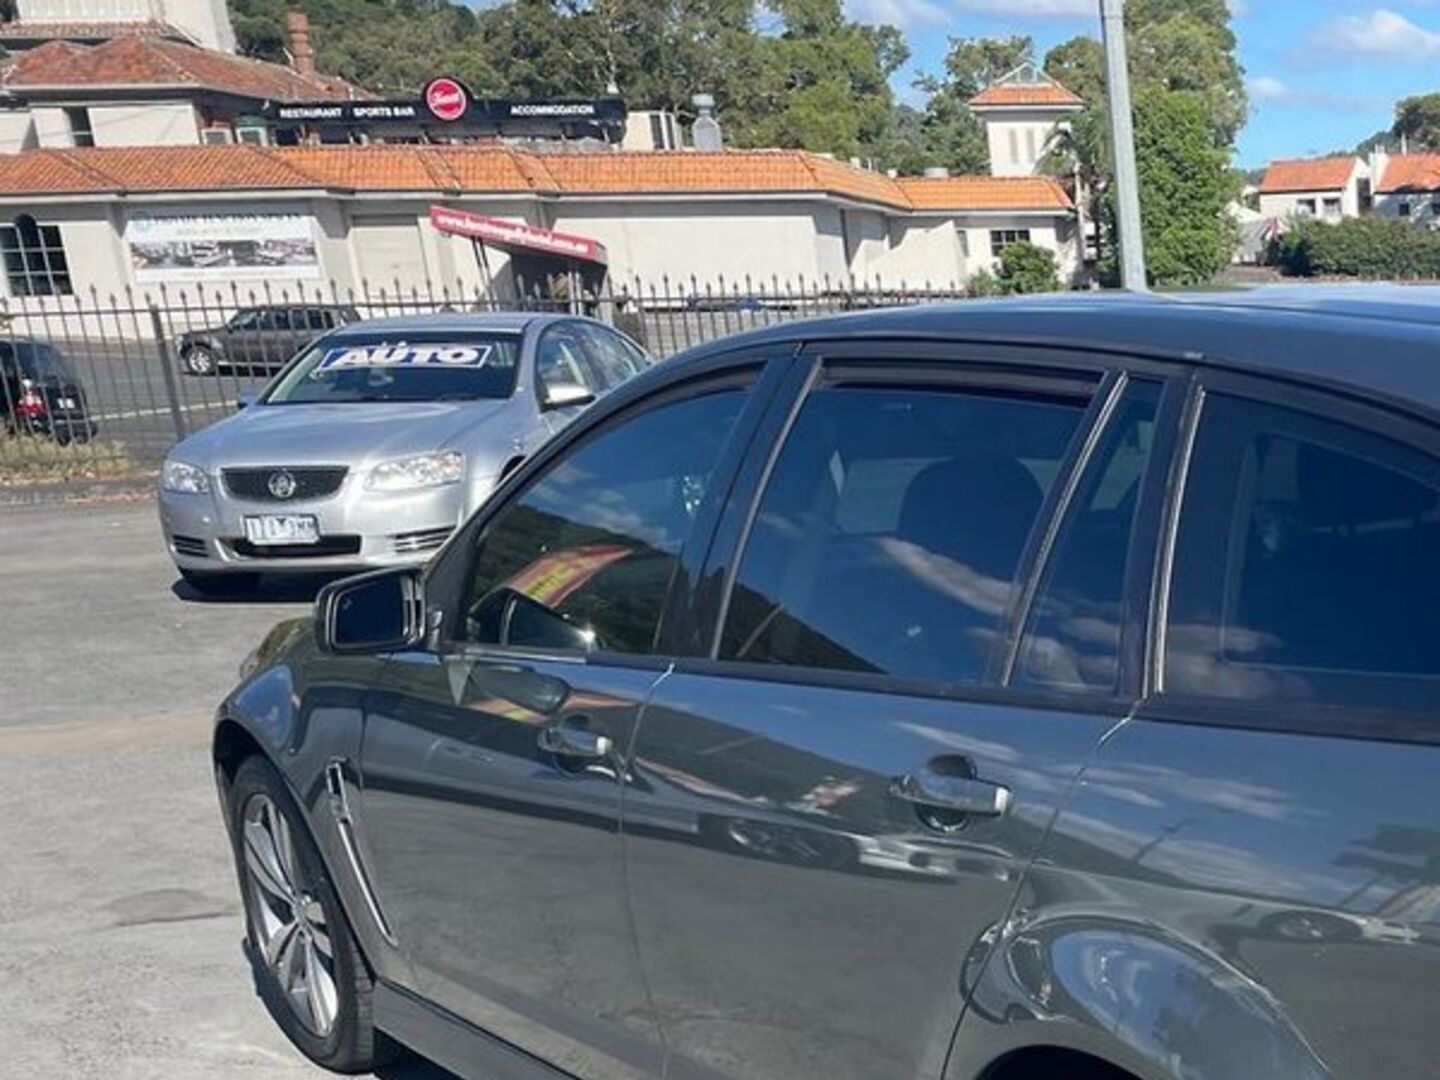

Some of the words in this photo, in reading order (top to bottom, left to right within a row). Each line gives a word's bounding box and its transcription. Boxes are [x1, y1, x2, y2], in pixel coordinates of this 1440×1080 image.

[280, 106, 342, 119] RESTAURANT
[353, 106, 392, 118] SPORTS
[393, 105, 416, 118] BAR
[511, 103, 596, 117] ACCOMMODATION
[328, 346, 480, 368] AUTO
